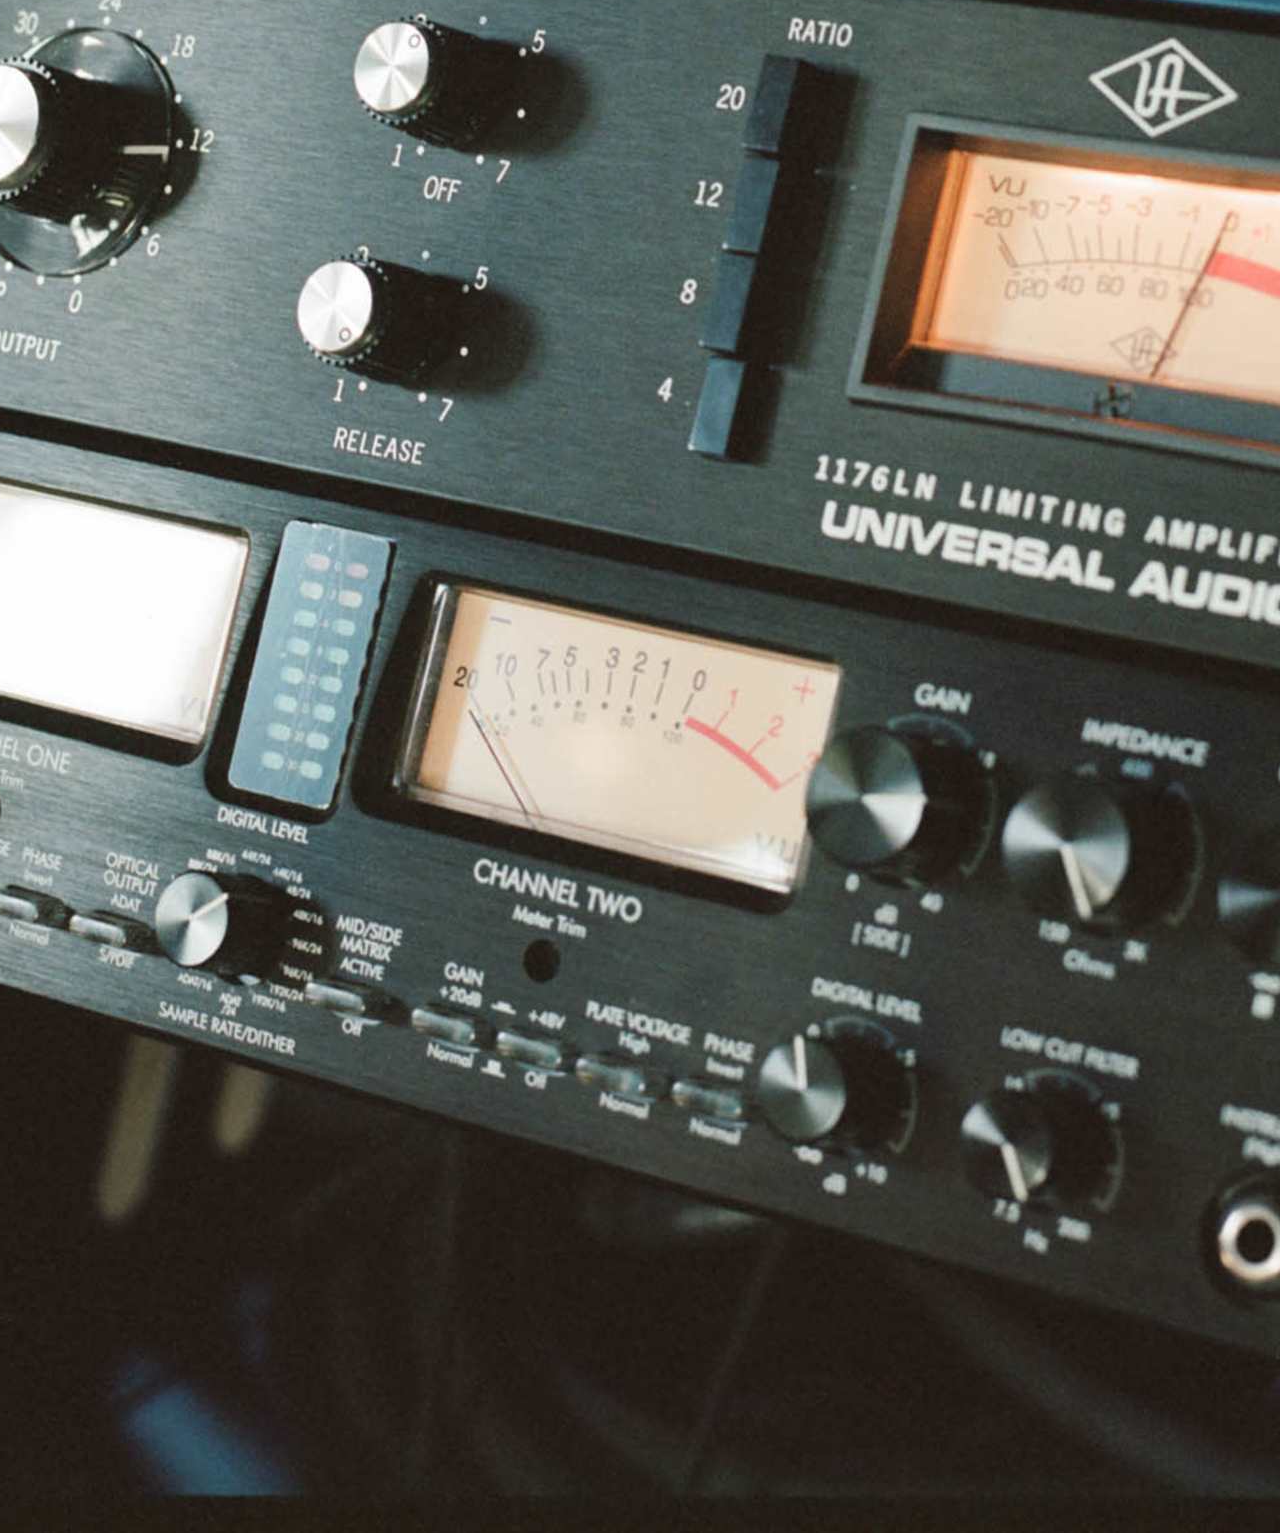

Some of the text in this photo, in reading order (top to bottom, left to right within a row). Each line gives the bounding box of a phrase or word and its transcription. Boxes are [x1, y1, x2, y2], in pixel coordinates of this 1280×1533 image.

[13, 11, 39, 35] 30
[787, 17, 854, 48] RATIO
[171, 34, 196, 58] 18
[530, 29, 546, 54] 5
[715, 83, 746, 112] 20
[189, 129, 215, 153] 12
[391, 143, 404, 167] 1
[496, 160, 511, 184] 7
[423, 175, 462, 203] OFF
[693, 180, 723, 208] 12
[987, 174, 1026, 198] VU
[973, 210, 1014, 229] -20
[146, 233, 161, 257] 6
[474, 266, 489, 291] 5
[679, 279, 698, 305] 8
[1020, 274, 1168, 301] 20 40 80
[332, 379, 344, 402] 1
[657, 377, 675, 403] 4
[438, 397, 454, 422] 7
[333, 426, 426, 466] RELEASE
[814, 454, 938, 501] 1176LN
[959, 480, 1128, 537] LIMITING
[821, 500, 1117, 592] UNIVERSAL
[453, 646, 707, 692] 20 5 3 2 0
[913, 683, 973, 715] GAIN
[1080, 717, 1210, 767] IMPEDANCE
[26, 743, 73, 776] ONE
[216, 805, 309, 846] DIGITAL LEVEL
[22, 846, 63, 871] PHASE
[105, 851, 161, 882] OPTICAL
[102, 869, 159, 899] OUTPUT
[473, 857, 642, 924] CHANNEL TWO
[109, 891, 142, 914] ADAT
[8, 921, 52, 947] Normal
[336, 915, 404, 946] MID/SIDE
[512, 905, 587, 939] Meter Trim
[340, 934, 392, 963] MATRIX
[340, 957, 386, 981] ACTIVE
[444, 961, 485, 987] GAIN
[439, 985, 482, 1009] +20dB
[158, 1002, 296, 1056] SAMPLE RATE/DITHER
[528, 1009, 566, 1030] +48V
[586, 1000, 692, 1047] PLATE VOLTAGE
[426, 1041, 474, 1068] Normal
[703, 1032, 755, 1064] PHASE
